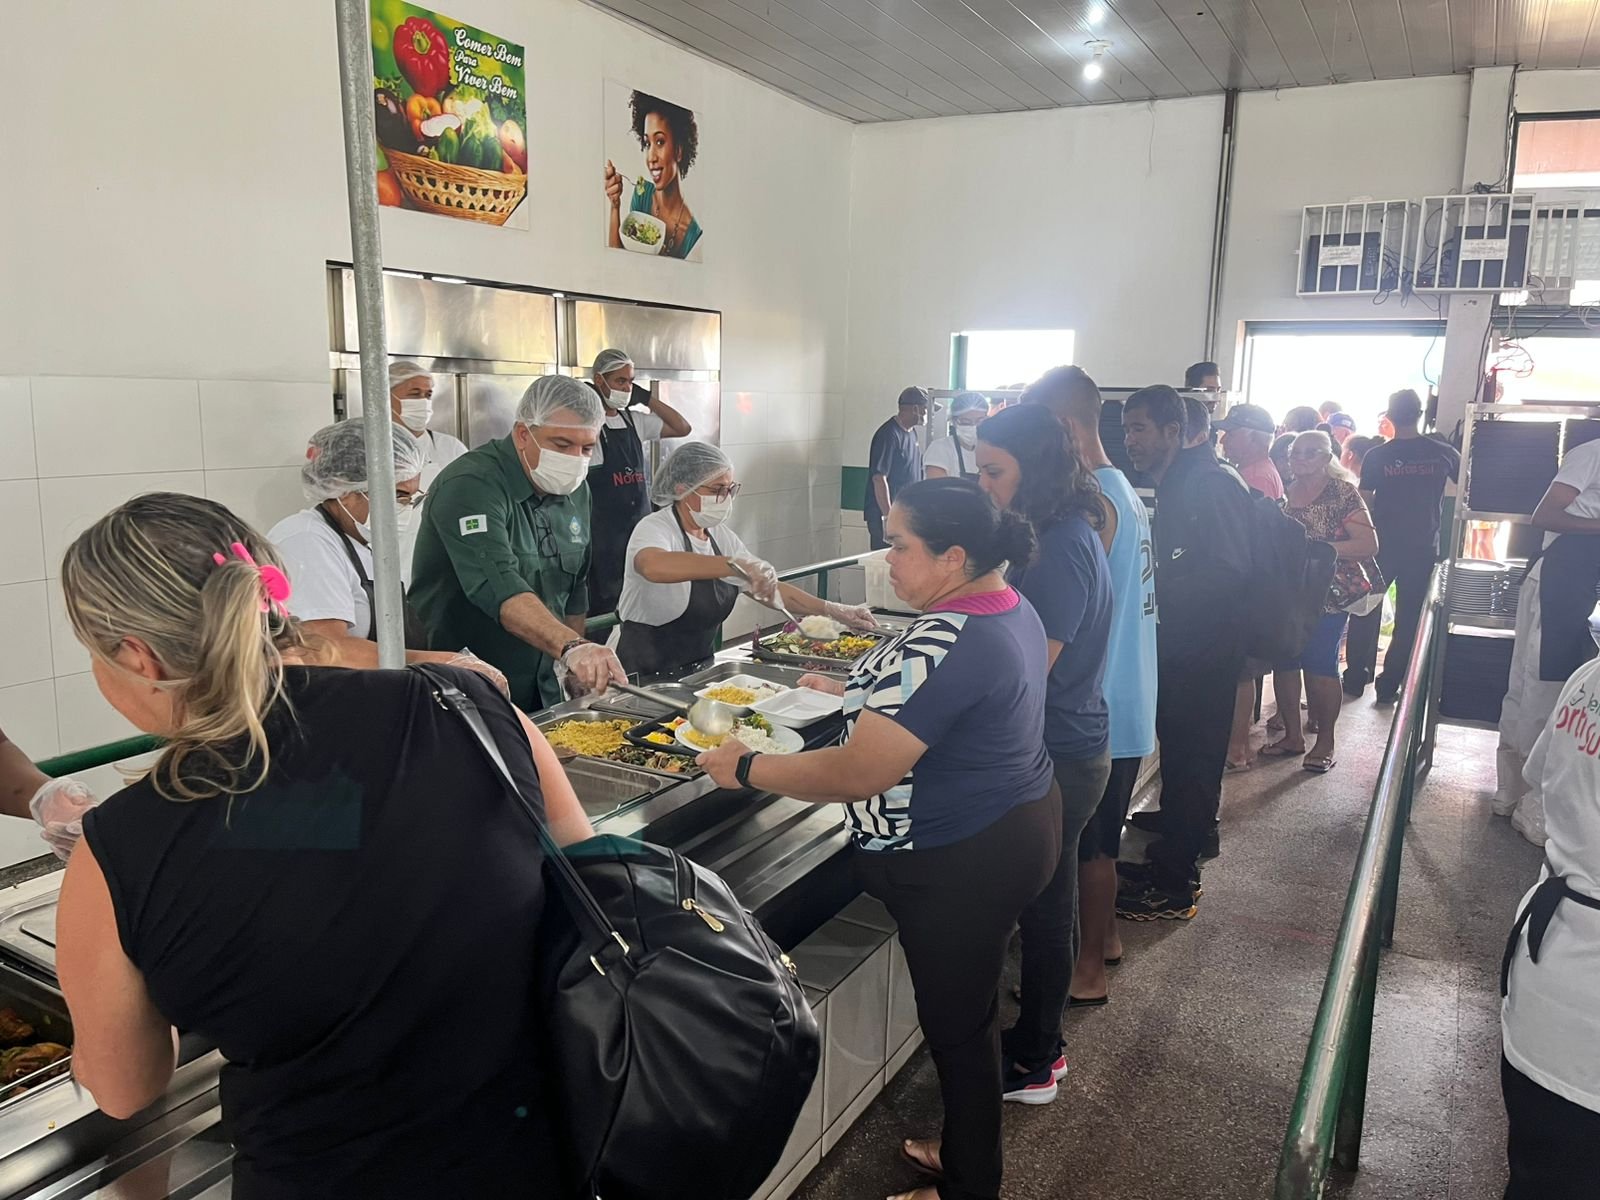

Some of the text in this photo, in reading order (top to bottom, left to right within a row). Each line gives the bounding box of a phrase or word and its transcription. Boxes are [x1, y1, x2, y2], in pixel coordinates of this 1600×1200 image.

[454, 28, 522, 67] Comer Bem
[455, 49, 478, 66] Para
[455, 64, 518, 99] Viver Bem
